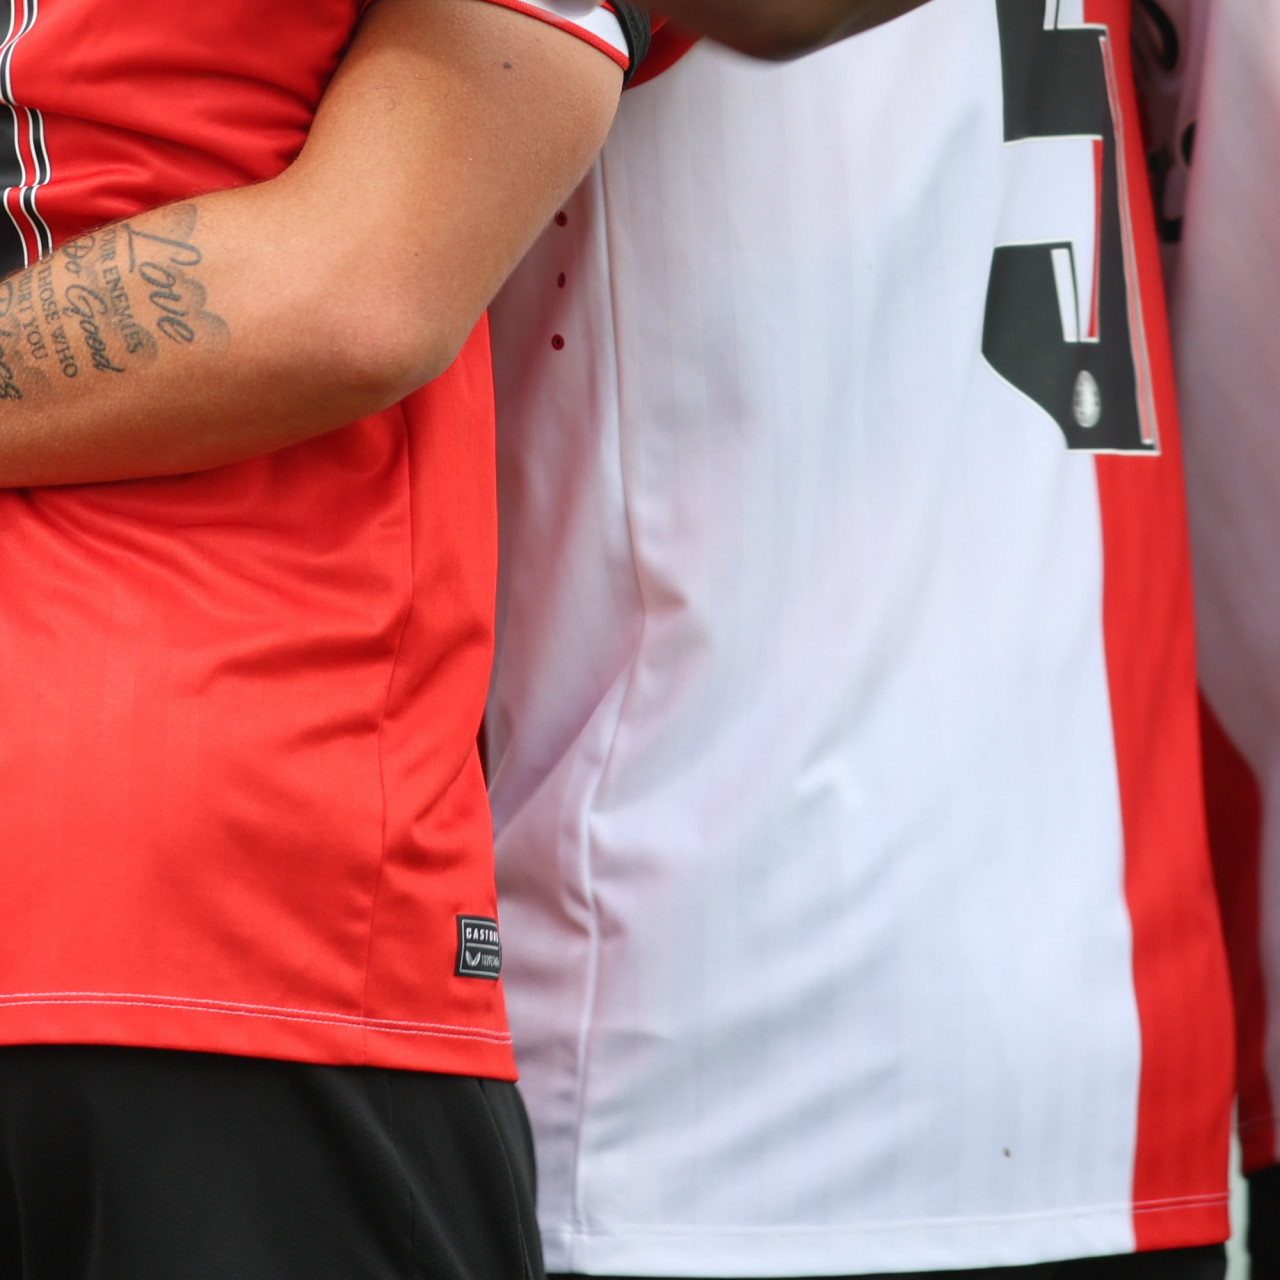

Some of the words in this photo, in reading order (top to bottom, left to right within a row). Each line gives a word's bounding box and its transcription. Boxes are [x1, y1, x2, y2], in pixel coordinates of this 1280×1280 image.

[103, 266, 145, 354] ENEMIES
[122, 223, 202, 344] Love
[22, 317, 49, 360] YOU
[50, 324, 79, 378] WHO
[62, 283, 126, 373] Good
